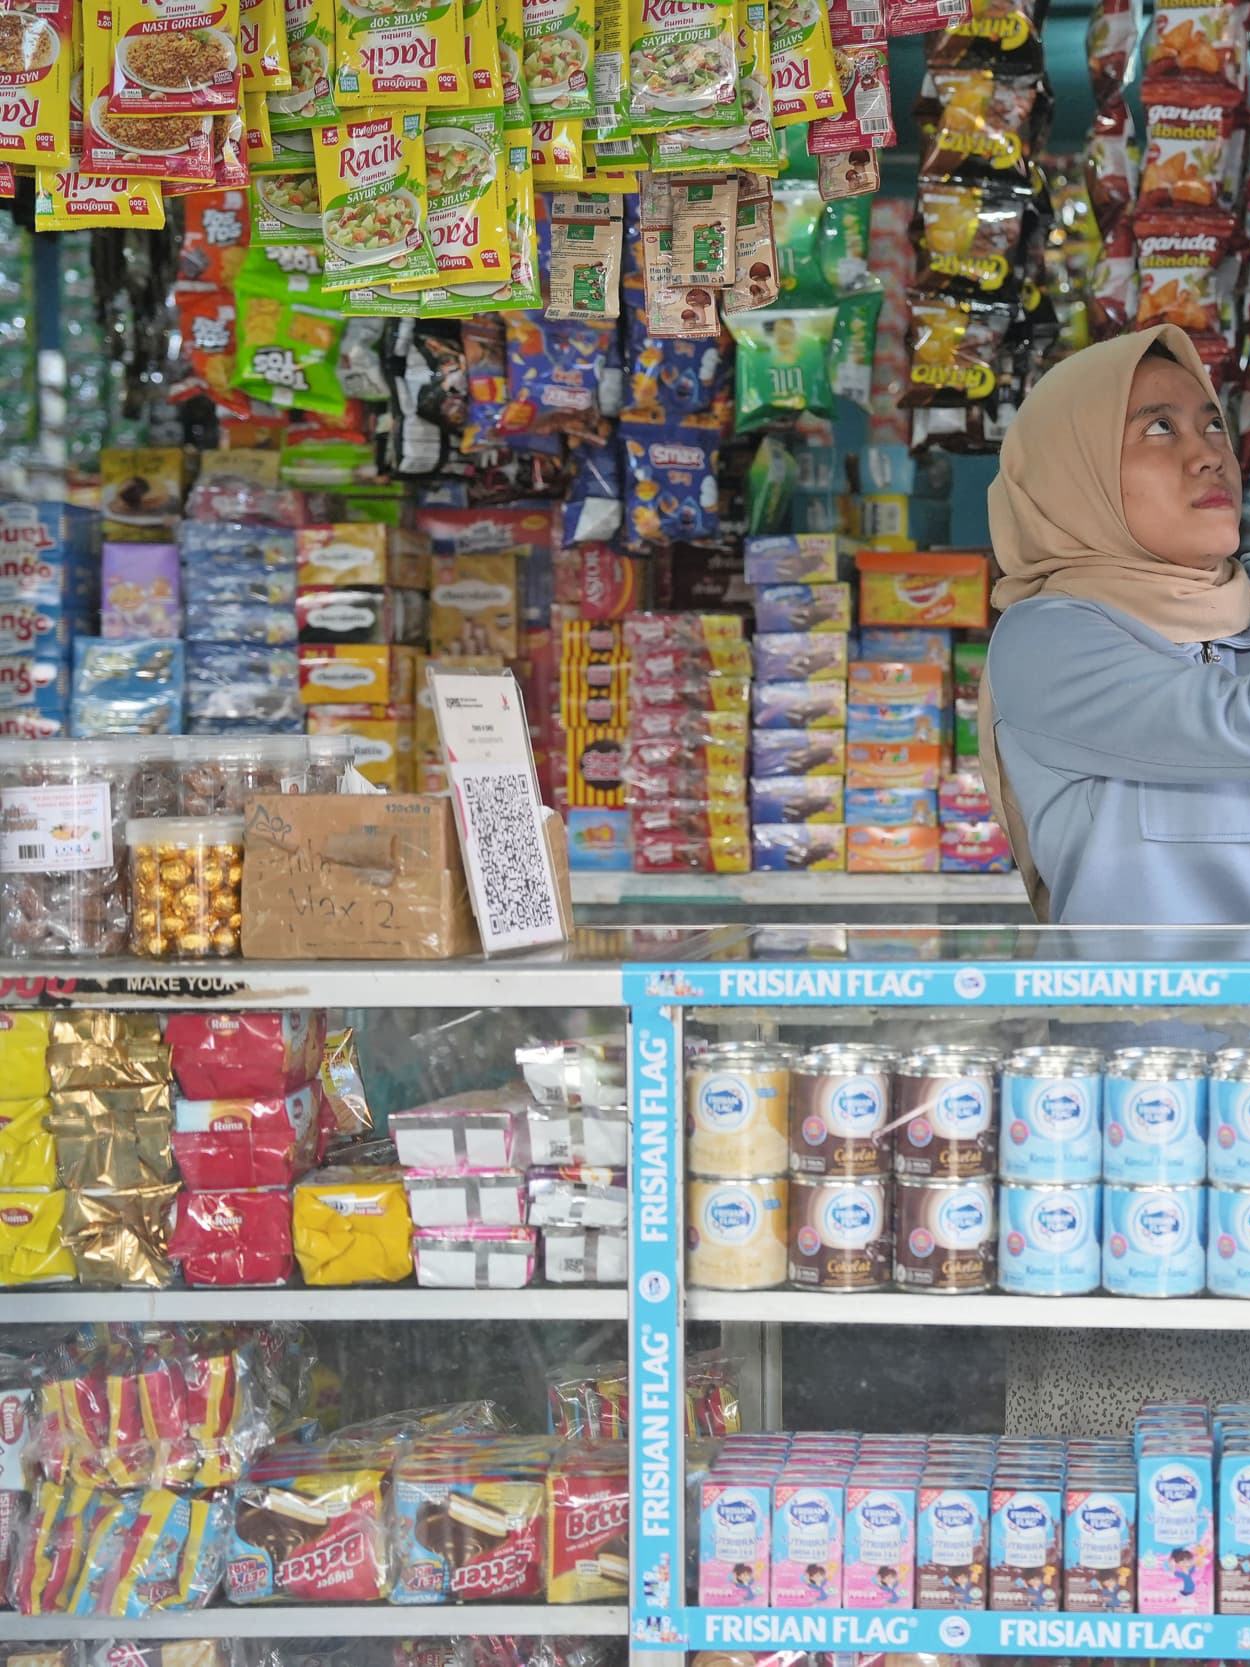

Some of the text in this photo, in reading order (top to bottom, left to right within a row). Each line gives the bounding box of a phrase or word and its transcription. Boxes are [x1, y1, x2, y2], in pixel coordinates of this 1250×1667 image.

[165, 4, 196, 13] Bumbu
[526, 10, 554, 21] Bumbu
[142, 16, 212, 33] NASI GORENG
[370, 11, 428, 28] SAYUR SOP
[664, 17, 694, 27] Bumbu
[381, 31, 412, 40] Bumbu
[524, 21, 563, 37] YUR SOP
[642, 29, 711, 48] SAYUR LODEH
[773, 32, 803, 49] SAYUR
[360, 37, 438, 75] Racik
[15, 71, 39, 84] NASI
[377, 78, 421, 90] Indofood
[1148, 105, 1223, 125] garuda
[351, 121, 388, 136] Indofood
[339, 134, 403, 177] Racik
[361, 170, 387, 182] Bumbu
[347, 181, 395, 204] SAYUR SOP
[441, 191, 470, 206] SAYUR
[70, 201, 113, 213] Indofood
[430, 217, 479, 247] Rac
[1141, 235, 1217, 254] garuda
[375, 900, 394, 929] 2
[127, 977, 180, 991] MAKE
[719, 969, 841, 997] FRISIAN
[1014, 969, 1138, 997] FRISIAN
[211, 1018, 240, 1030] Roma
[214, 1119, 243, 1132] Roma
[833, 1149, 877, 1163] Cokelat
[641, 1120, 668, 1242] FRISIAN
[2, 1212, 29, 1225] Roma
[215, 1214, 244, 1226] Roma
[827, 1259, 871, 1274] Cokelat
[642, 1419, 669, 1536] FRISIAN
[565, 1500, 628, 1540] Bette
[275, 1533, 364, 1586] Better
[316, 1570, 355, 1589] Bigger
[706, 1615, 828, 1643] FRISIAN
[1000, 1619, 1122, 1648] FRISIAN
